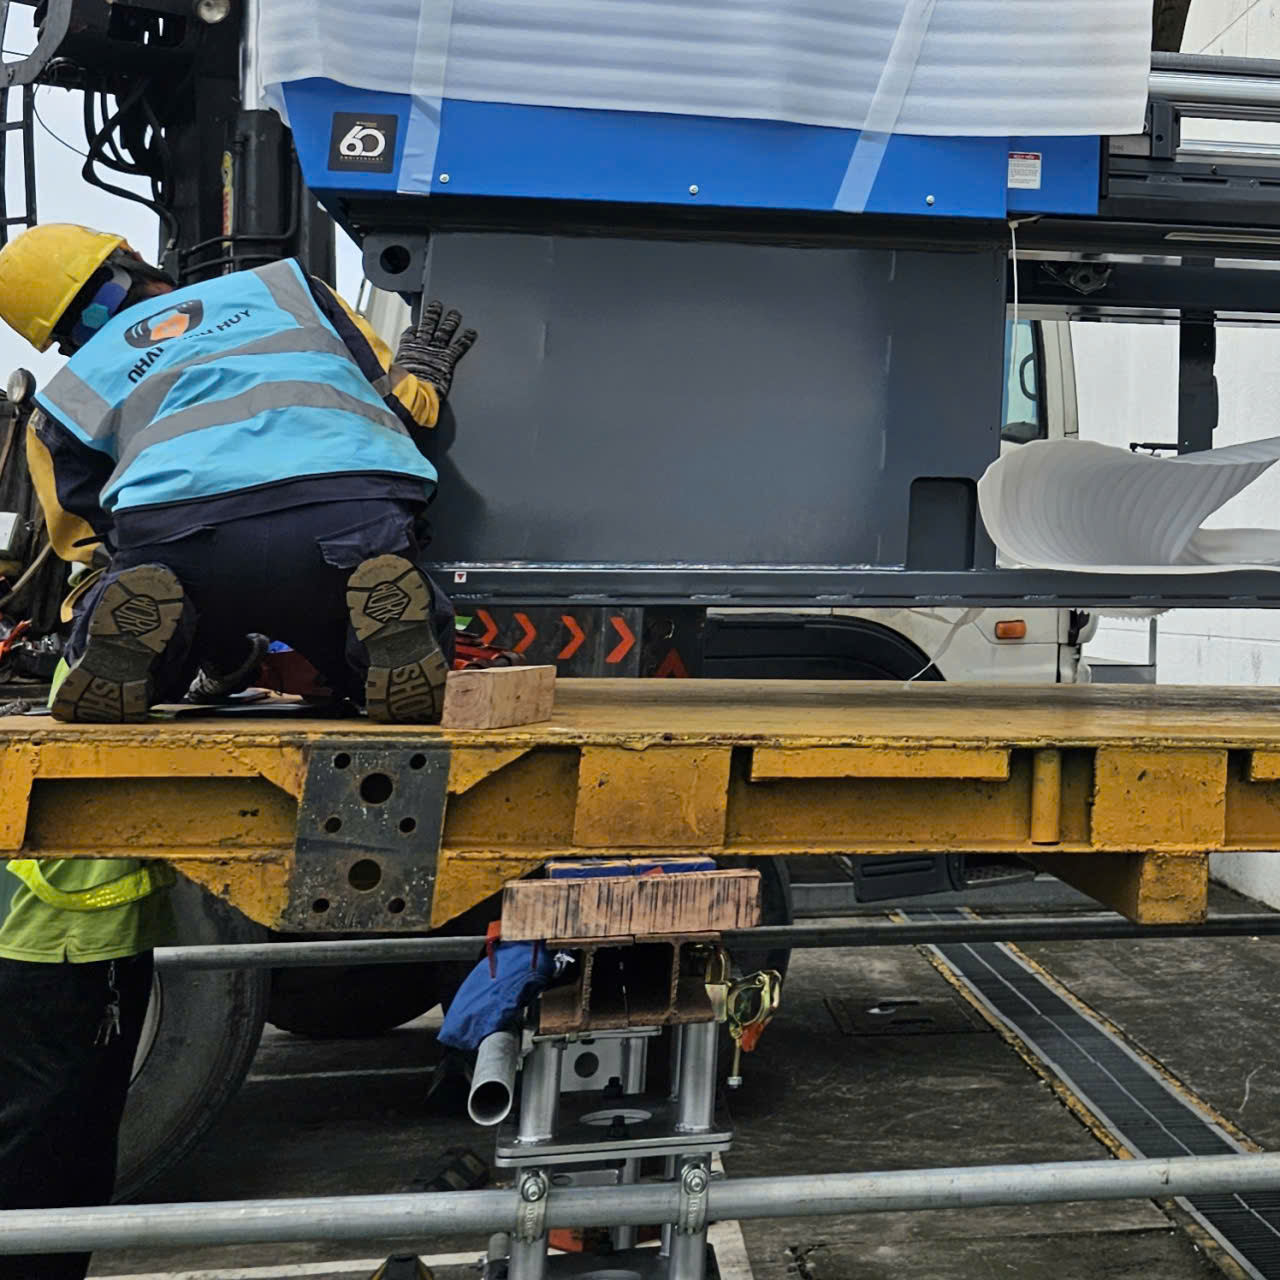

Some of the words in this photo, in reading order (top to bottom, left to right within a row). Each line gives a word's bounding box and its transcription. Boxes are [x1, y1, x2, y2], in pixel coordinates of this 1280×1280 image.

[339, 125, 386, 156] 60
[216, 309, 251, 331] HUY
[364, 582, 409, 623] WORK
